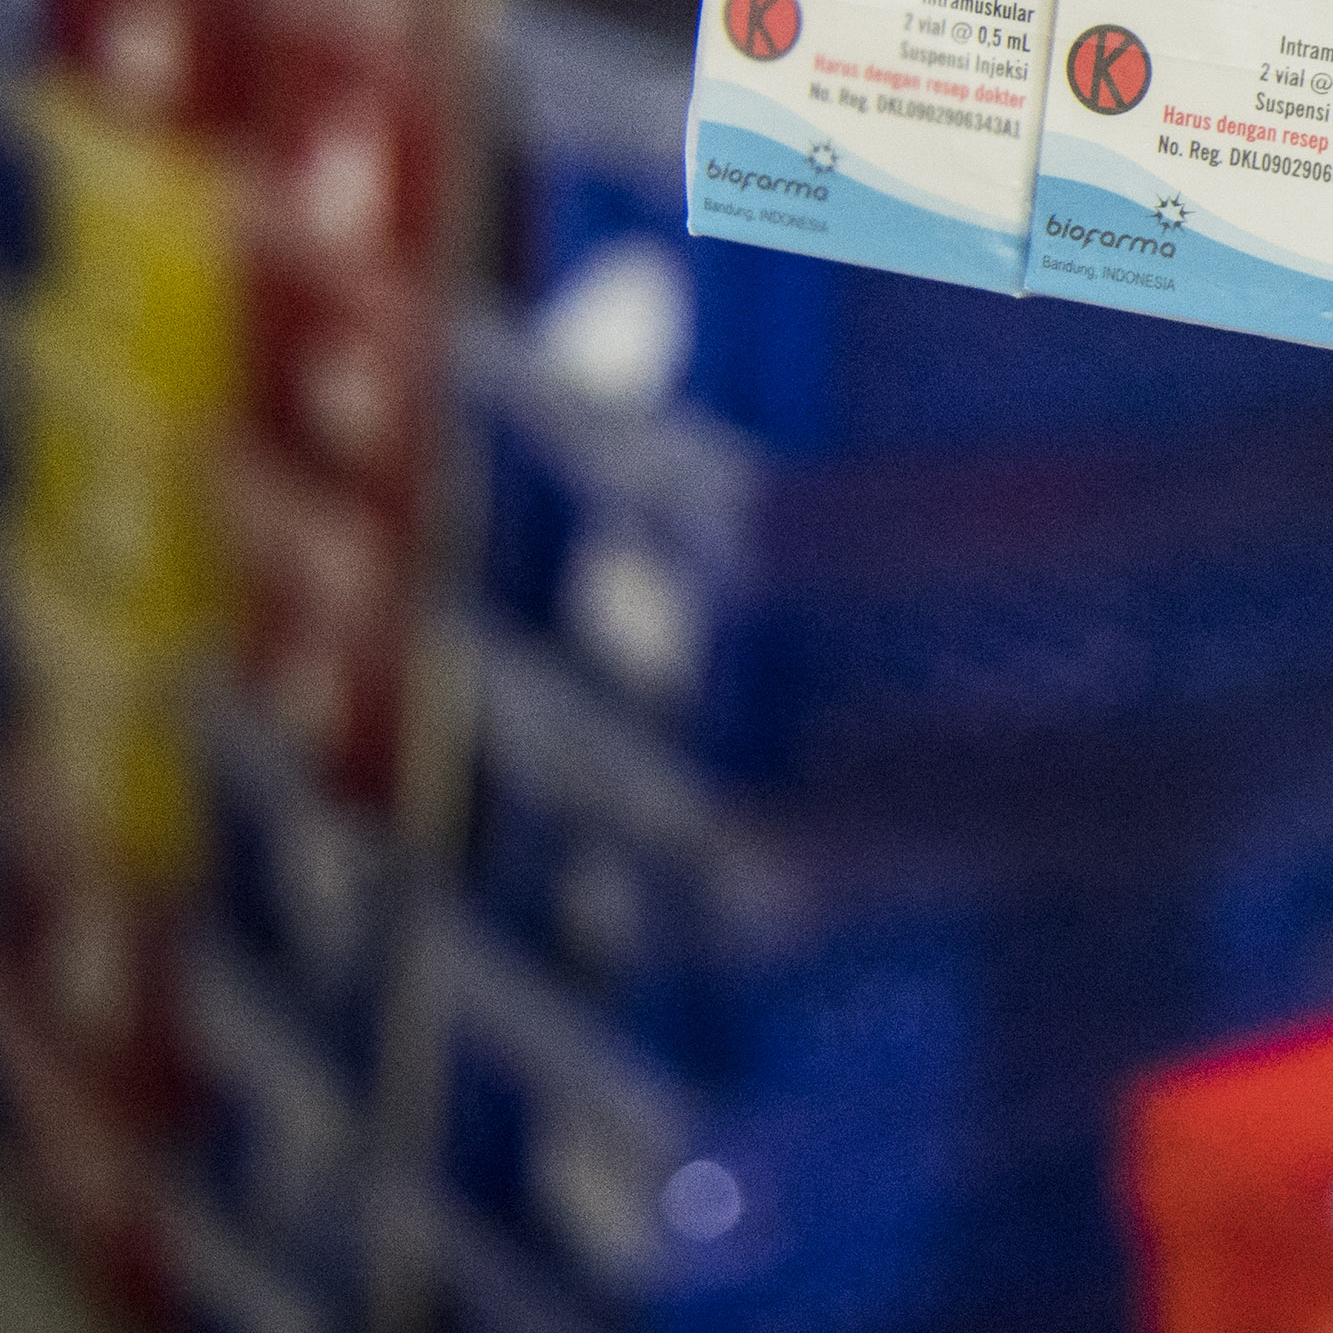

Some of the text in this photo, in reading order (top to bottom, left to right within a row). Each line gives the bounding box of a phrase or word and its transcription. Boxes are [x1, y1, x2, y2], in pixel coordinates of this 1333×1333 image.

[978, 26, 1001, 47] 0,5
[1260, 63, 1270, 81] 2
[1276, 67, 1305, 87] vial
[1310, 73, 1333, 94] @
[1256, 92, 1330, 122] Suspensi
[1163, 105, 1211, 130] Harus
[1217, 115, 1277, 142] dengan
[1282, 130, 1328, 154] resep
[1158, 136, 1183, 156] No.
[1189, 141, 1222, 167] Reg.
[706, 159, 829, 201] biofarma
[1046, 214, 1176, 258] biofarma
[1042, 255, 1175, 290] Bandung, INDONESIA
